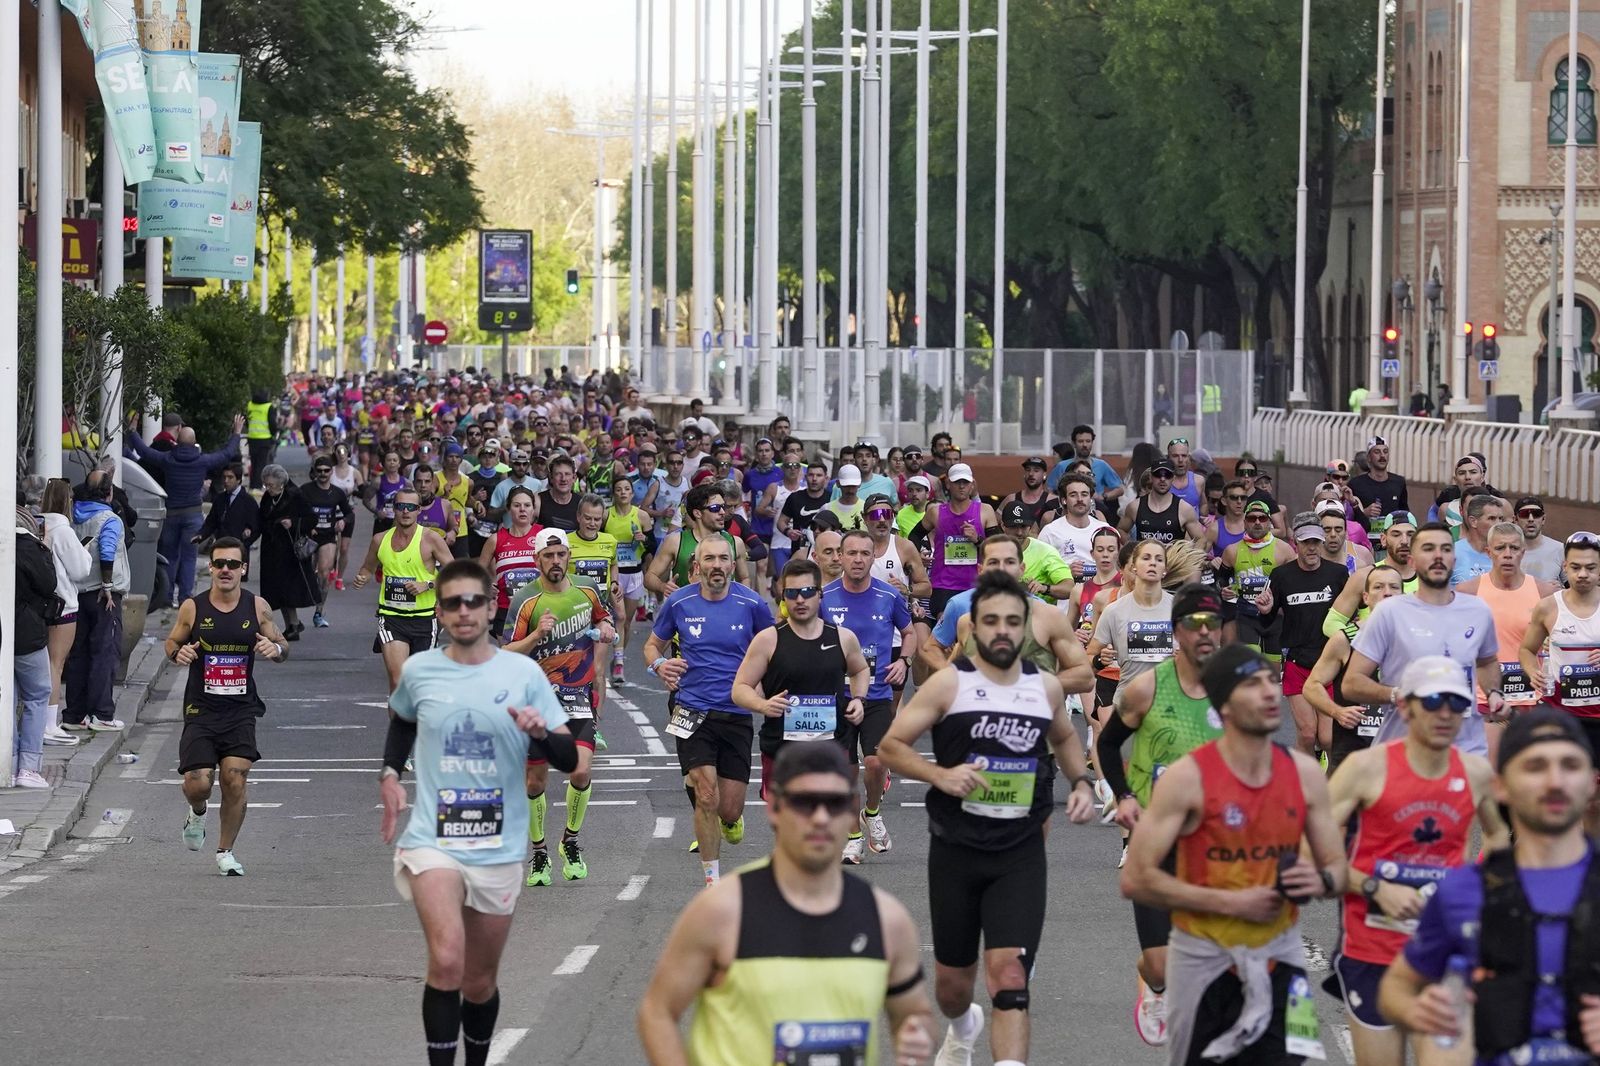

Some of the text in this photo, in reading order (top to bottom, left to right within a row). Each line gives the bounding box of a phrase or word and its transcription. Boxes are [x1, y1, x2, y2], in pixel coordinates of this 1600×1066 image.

[391, 593, 407, 601] LEON
[204, 678, 247, 686] CALIL VALOTO
[1576, 678, 1592, 686] 4009
[1503, 683, 1525, 693] FRED
[1570, 686, 1600, 697] PABLO
[795, 720, 826, 730] SALAS
[439, 759, 498, 775] SEVILLA
[992, 760, 1029, 770] ZURICH
[460, 791, 497, 801] ZURICH
[978, 790, 1018, 803] JAIME
[443, 822, 498, 836] REIXACH
[1402, 867, 1447, 880] ZURICH
[808, 1025, 863, 1042] ZURICH
